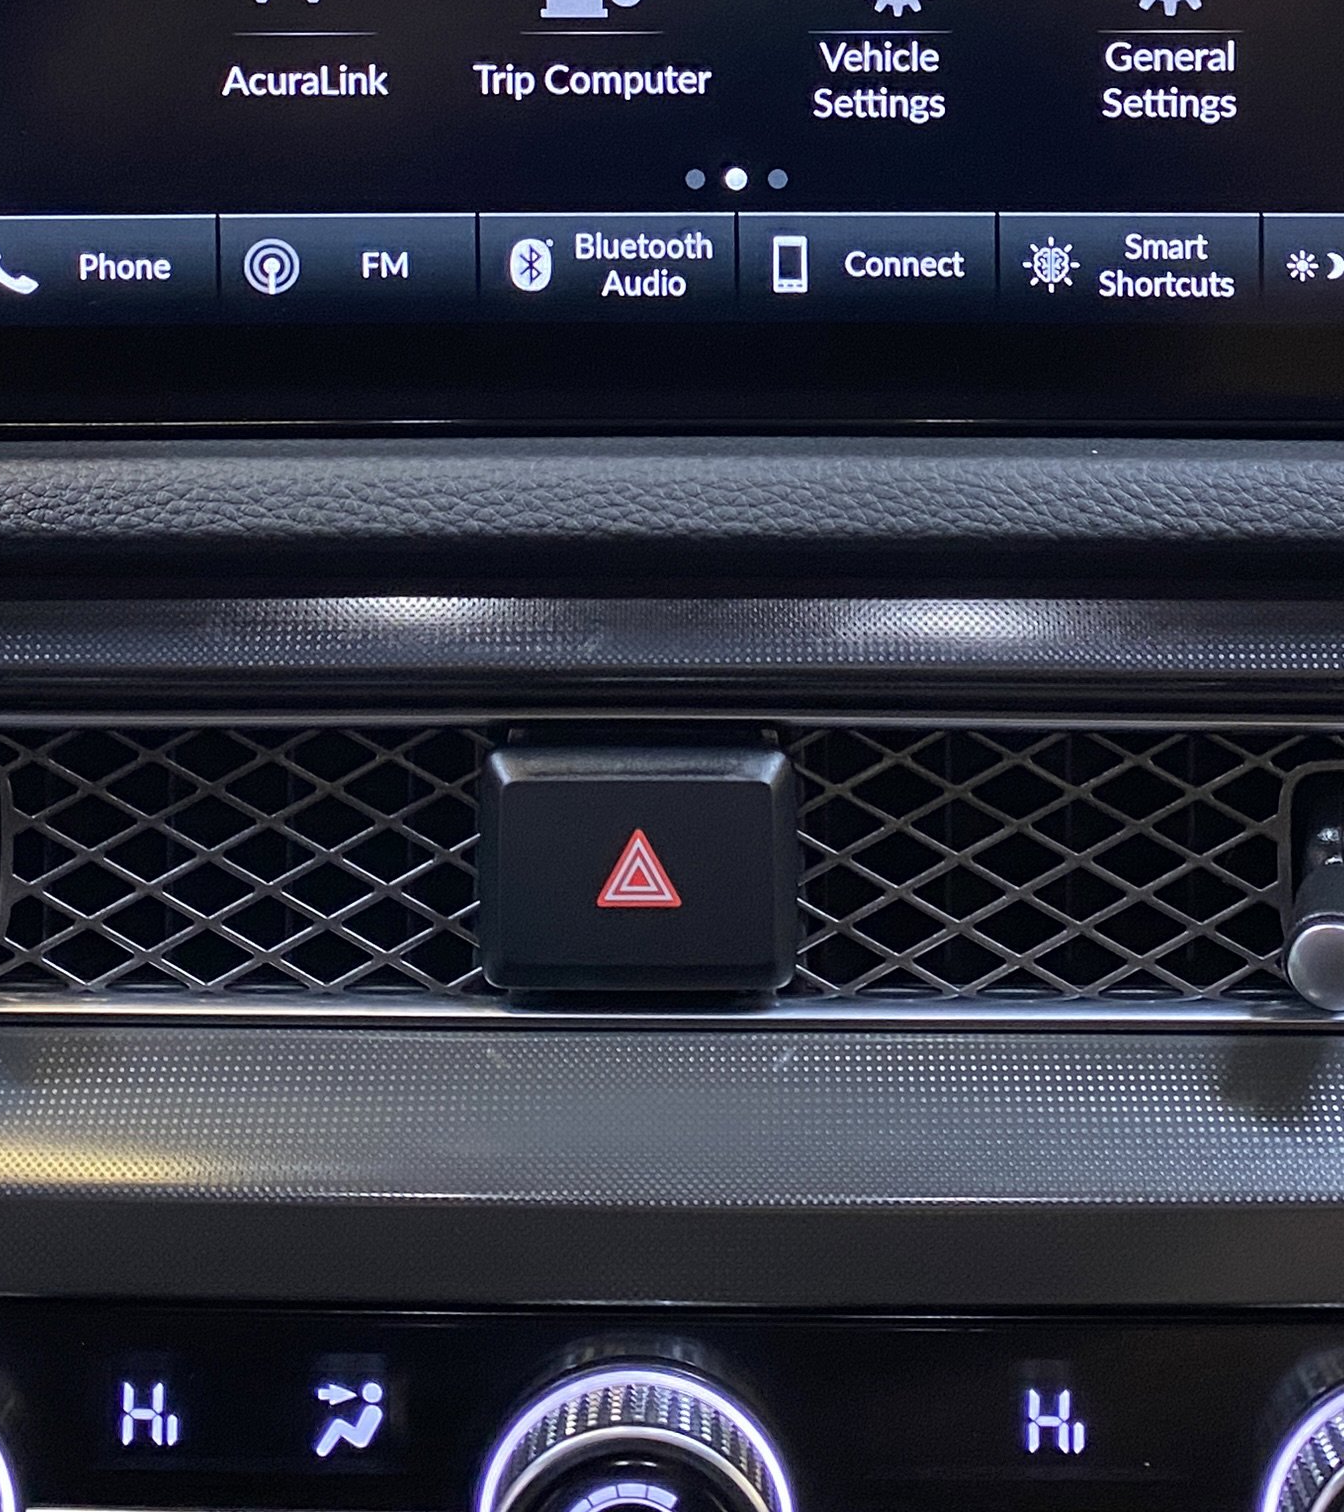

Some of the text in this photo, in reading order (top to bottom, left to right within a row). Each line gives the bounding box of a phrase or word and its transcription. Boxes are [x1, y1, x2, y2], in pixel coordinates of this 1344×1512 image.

[818, 40, 940, 73] Vehicle
[1104, 39, 1235, 72] General
[221, 63, 389, 97] AcuraLink
[472, 63, 713, 101] Trip Computer
[812, 86, 946, 125] Settings
[1101, 86, 1237, 125] Settings
[575, 231, 713, 260] Bluetooth
[1124, 232, 1209, 260] Smart
[79, 251, 172, 281] Phone
[362, 251, 409, 279] FM
[844, 250, 965, 278] Connect
[601, 268, 687, 297] Audio
[1098, 269, 1235, 298] Shortcuts
